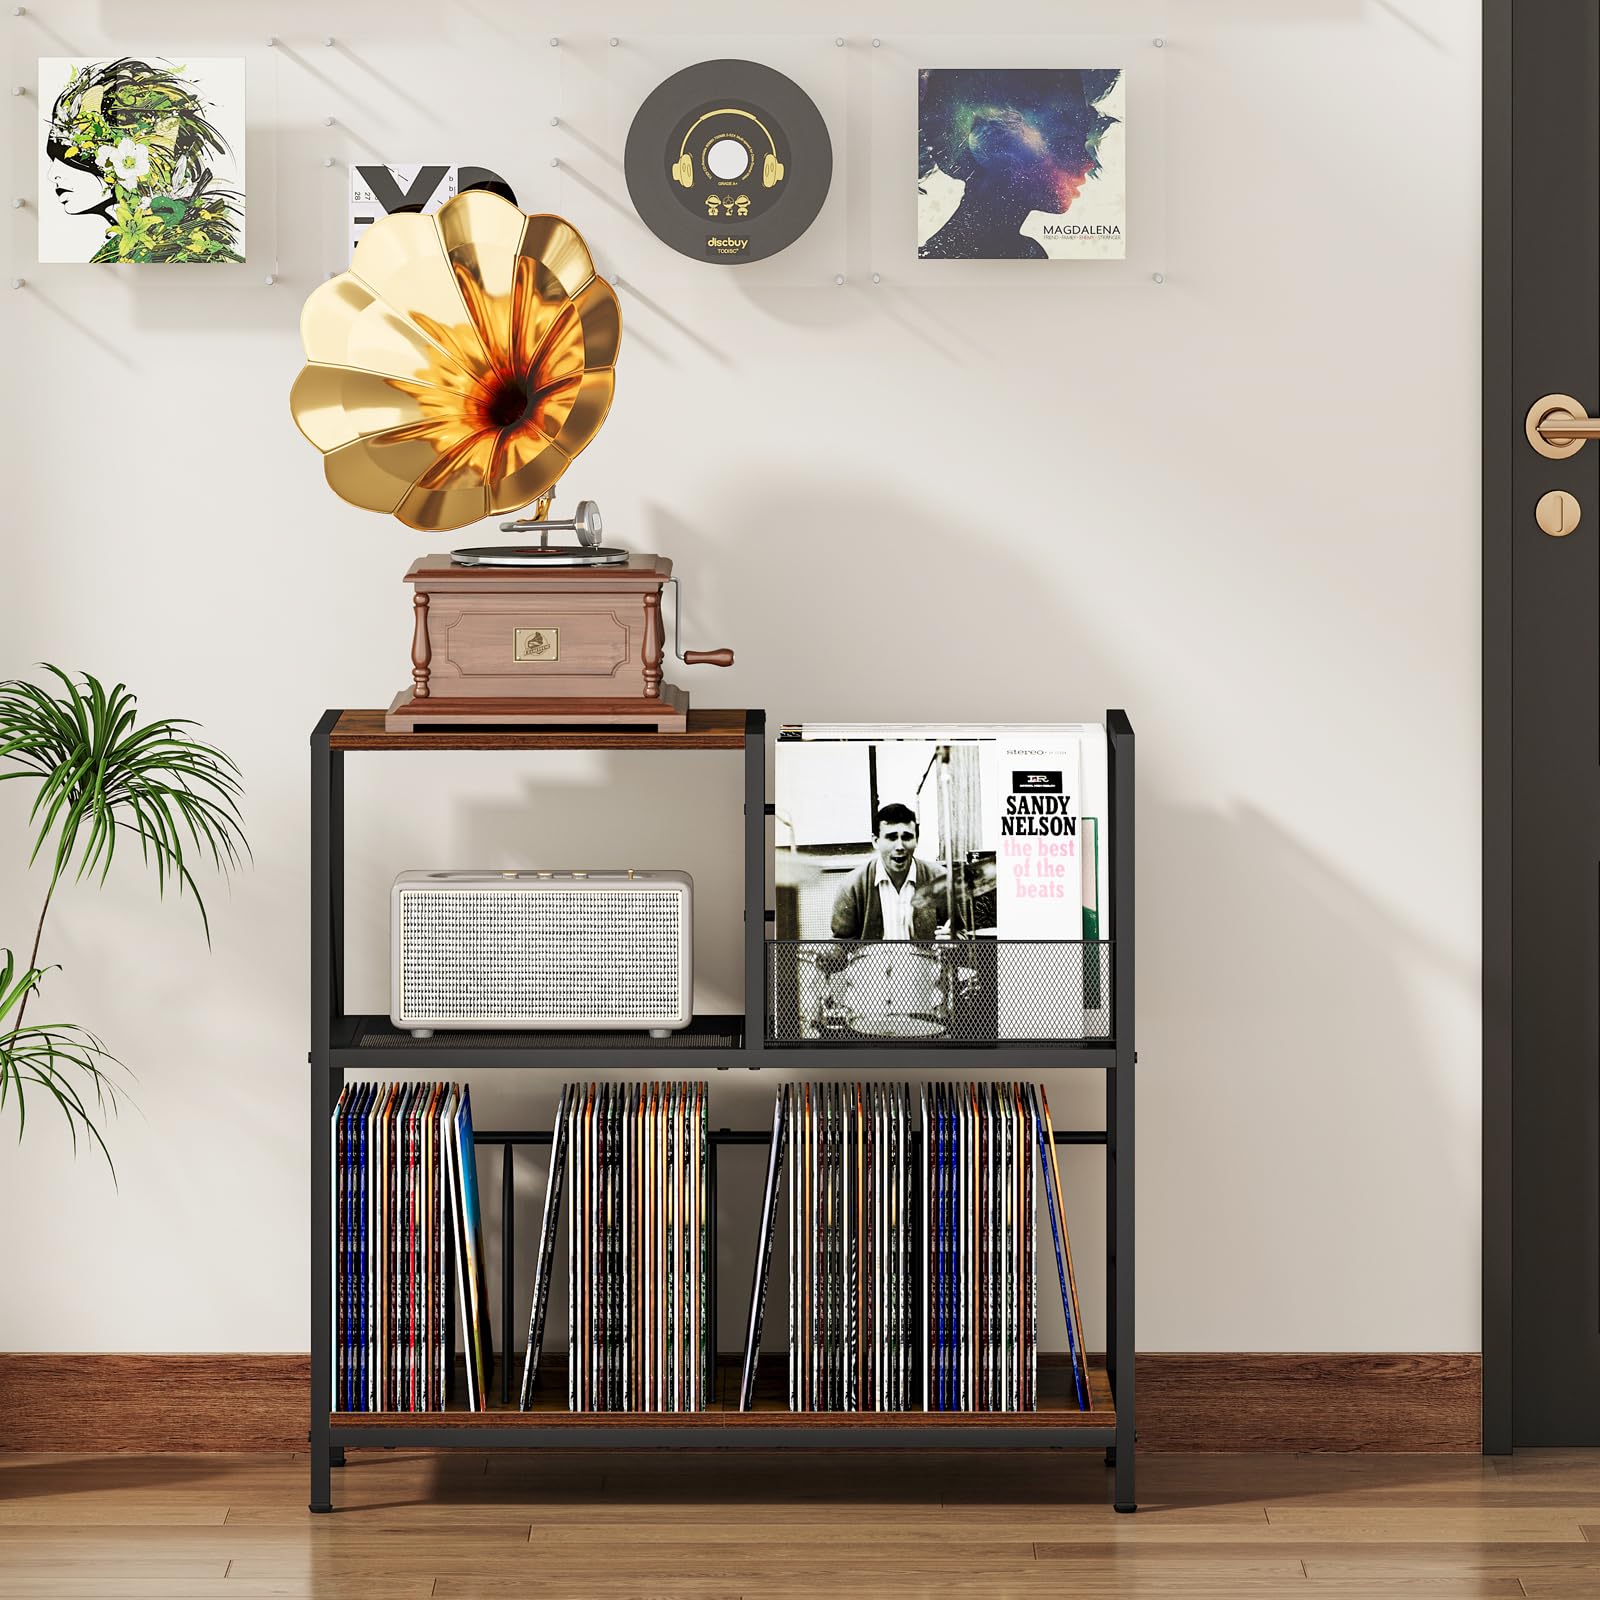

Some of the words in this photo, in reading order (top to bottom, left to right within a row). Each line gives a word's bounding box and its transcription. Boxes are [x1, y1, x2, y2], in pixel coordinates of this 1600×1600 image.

[354, 191, 361, 201] 28
[1043, 225, 1121, 235] MAGDALENA
[707, 237, 749, 249] discbuy
[1006, 795, 1071, 816] SANDY
[1001, 816, 1077, 836] NELSON
[1003, 837, 1033, 857] the
[1038, 837, 1075, 857] best
[1013, 858, 1030, 877] of
[1037, 858, 1065, 877] the
[1015, 878, 1065, 898] beats
